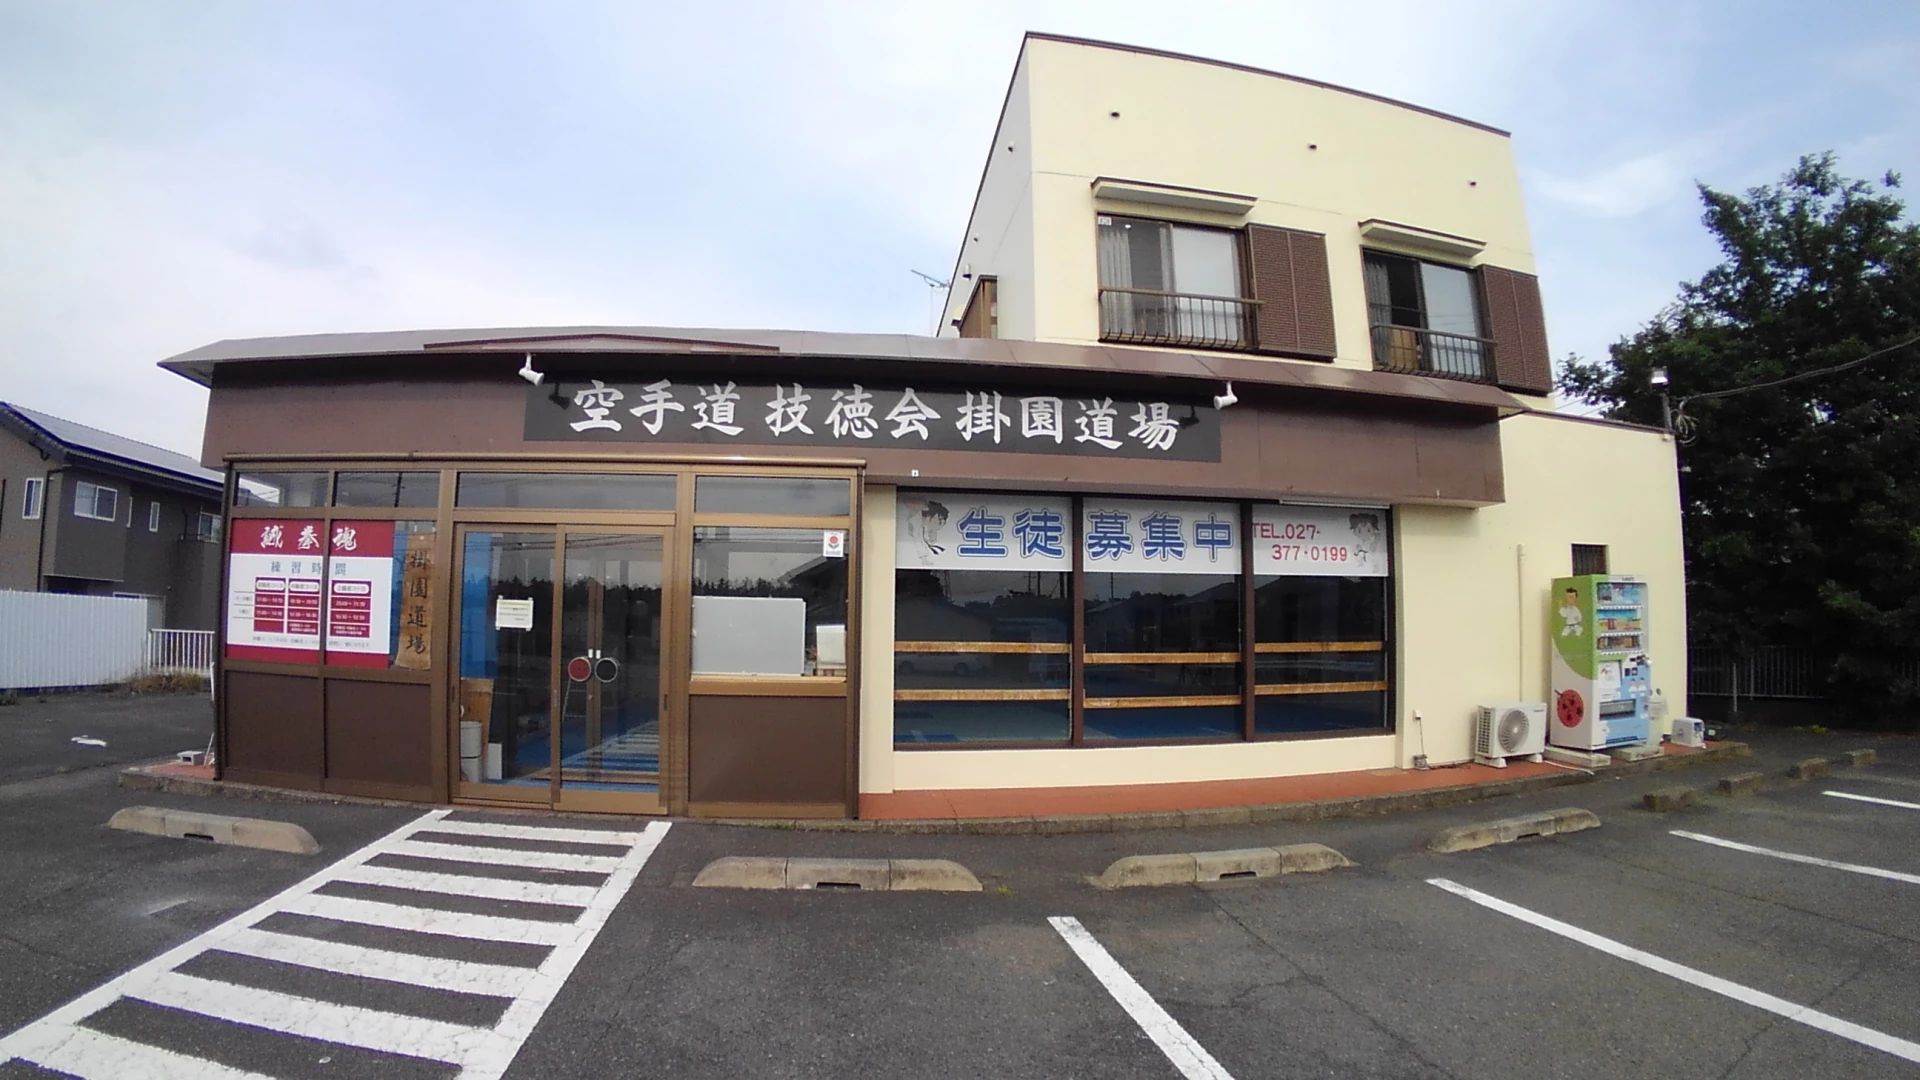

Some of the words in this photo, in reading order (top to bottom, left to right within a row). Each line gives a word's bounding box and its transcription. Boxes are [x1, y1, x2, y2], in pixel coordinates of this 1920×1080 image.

[956, 507, 1234, 562] 生徒募集中
